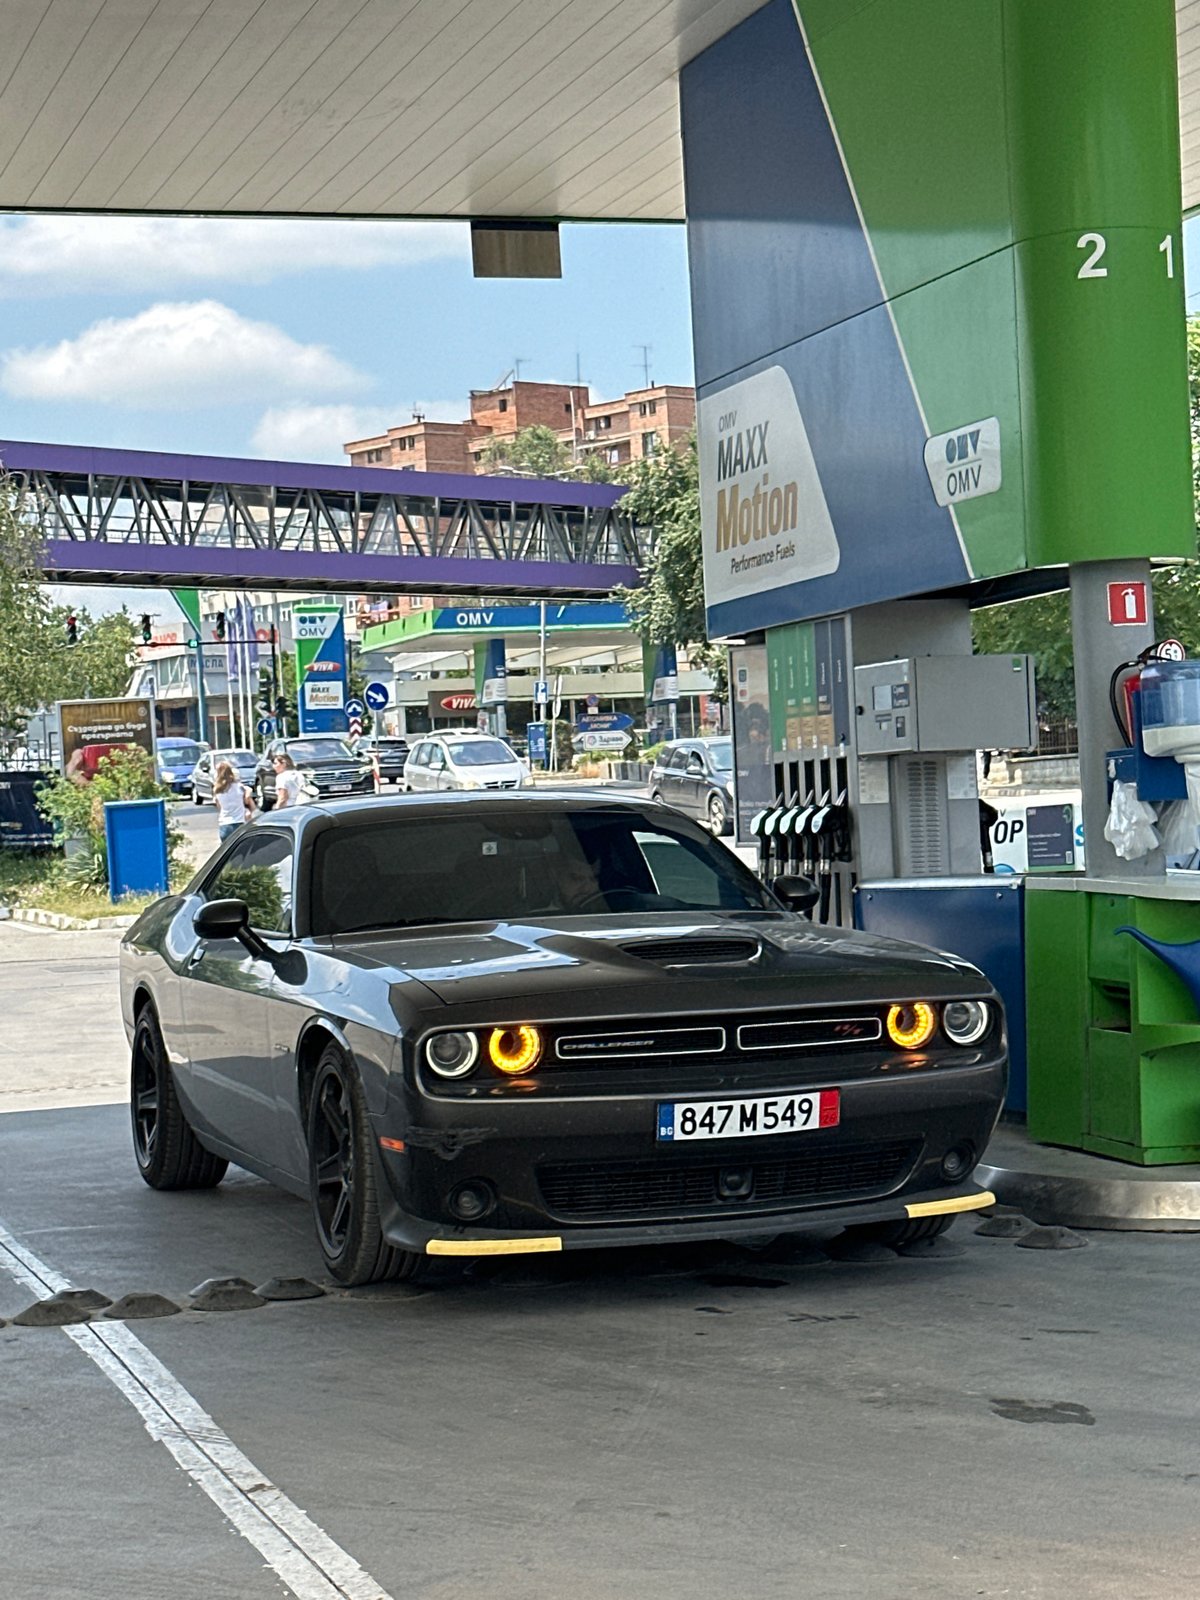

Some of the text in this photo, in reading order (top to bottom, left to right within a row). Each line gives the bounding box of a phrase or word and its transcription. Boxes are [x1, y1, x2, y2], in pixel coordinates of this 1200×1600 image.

[1077, 233, 1108, 279] 2
[1159, 235, 1174, 278] 1
[719, 411, 737, 432] OMV
[718, 420, 770, 483] MAXX
[946, 464, 982, 497] OMV
[716, 472, 798, 553] Motion
[730, 540, 795, 574] Performance Fuels
[456, 612, 494, 626] OMV
[299, 628, 327, 637] OMV
[190, 658, 224, 668] МСЛА
[312, 663, 334, 672] VIVA
[309, 693, 339, 703] Motion
[114, 723, 125, 732] да
[126, 722, 147, 731] бъде
[993, 819, 1025, 845] OP
[562, 1040, 655, 1050] CHALLENGER
[660, 1127, 673, 1136] BG
